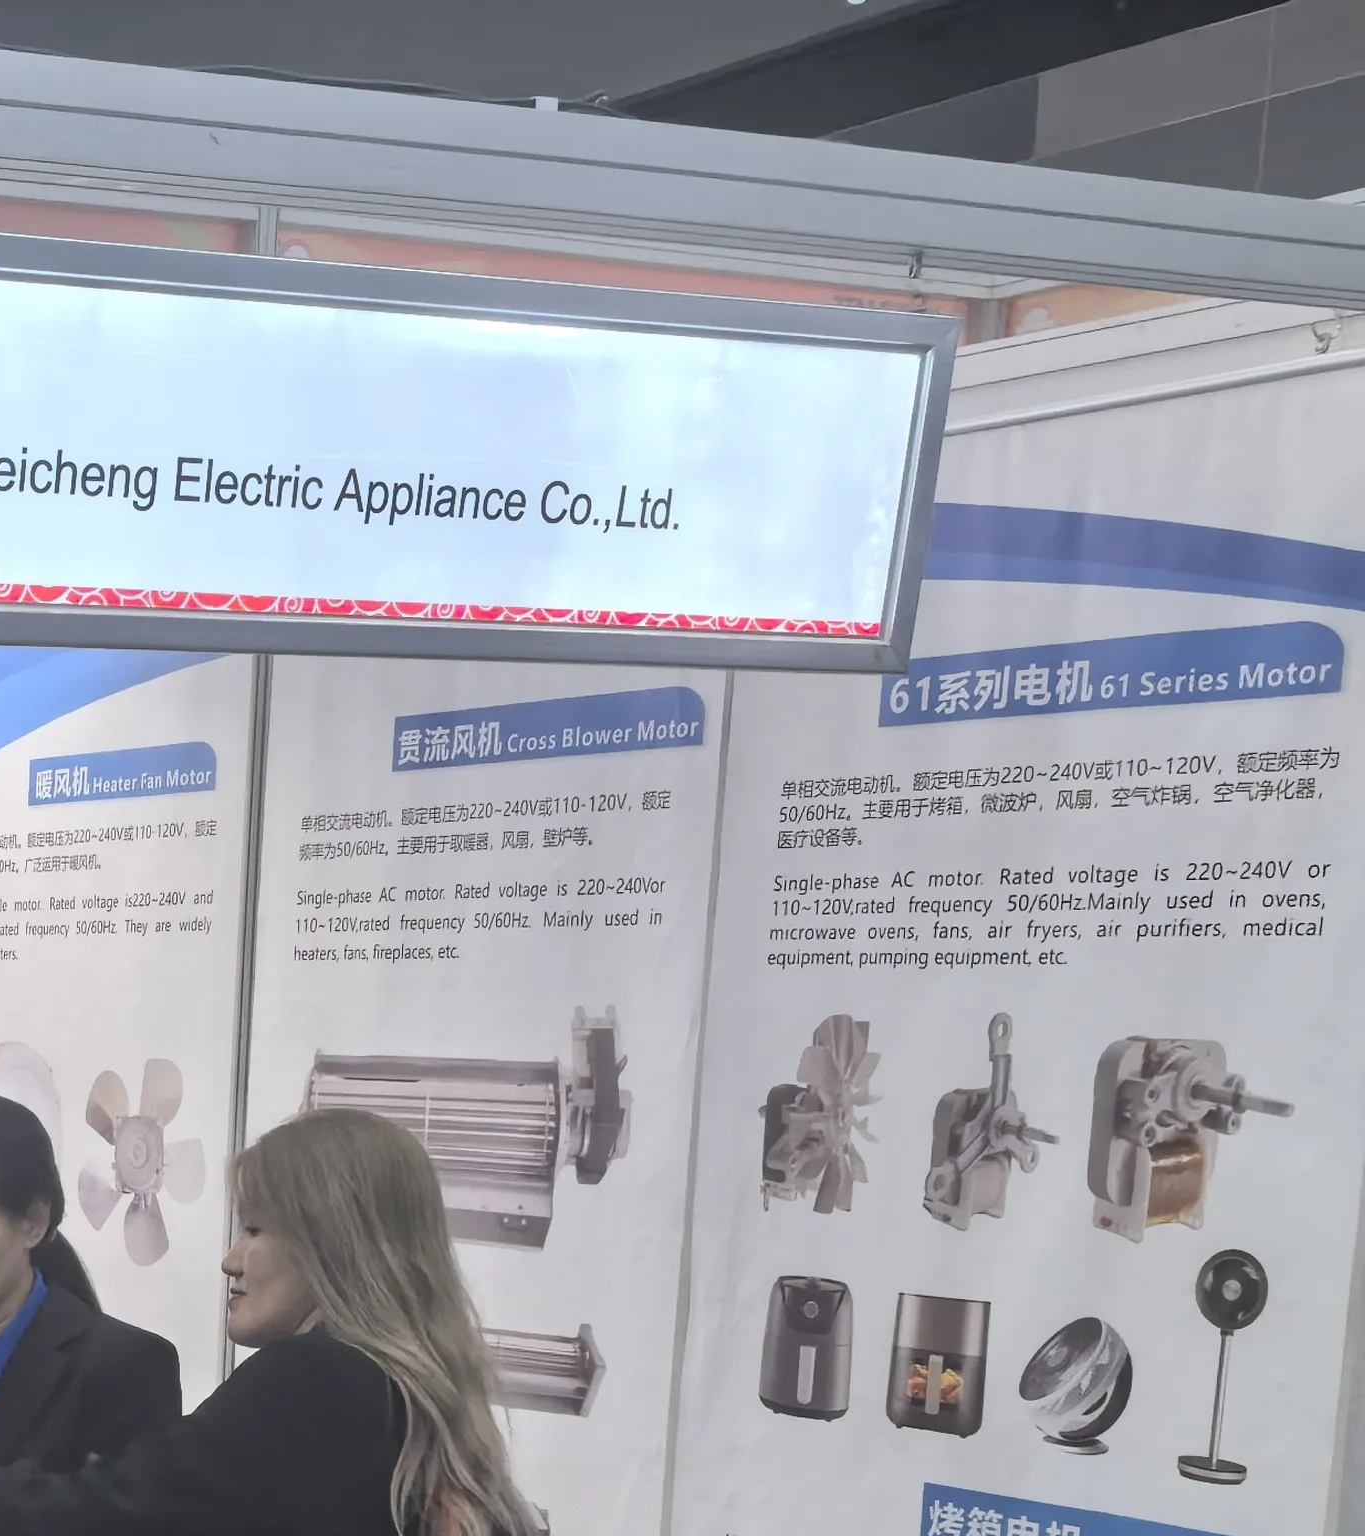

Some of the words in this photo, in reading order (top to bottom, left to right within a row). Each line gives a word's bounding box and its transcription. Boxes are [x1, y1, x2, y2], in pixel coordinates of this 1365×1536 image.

[174, 457, 323, 510] Electric
[334, 469, 526, 525] Appliance
[541, 481, 678, 533] Co.,Ltd.
[890, 660, 1093, 714] 61系列电机
[1101, 674, 1128, 698] 61
[1140, 672, 1228, 696] Series
[1239, 663, 1331, 688] Motor
[398, 721, 502, 765] 贯流风机
[508, 734, 555, 752] Cross
[562, 727, 632, 748] Blower
[638, 720, 698, 741] Motor
[36, 766, 89, 799] 暖风机
[93, 776, 137, 793] Heater
[141, 773, 161, 789] Fan
[167, 769, 211, 787] Motor
[773, 873, 879, 895] Single-phase
[891, 870, 915, 888] AC
[1000, 866, 1054, 885] Rated
[1069, 864, 1138, 888] voltage
[1155, 863, 1169, 882] is
[1308, 864, 1331, 878] or
[297, 888, 371, 909] Single-phase
[379, 886, 397, 902] AC
[455, 882, 490, 900] Rated
[499, 881, 547, 902] voltage
[557, 880, 567, 896] is
[909, 896, 993, 918] frequency
[1167, 890, 1213, 909] used
[1230, 890, 1245, 908] in
[401, 914, 465, 934] frequency
[543, 910, 593, 931] Mainly
[605, 909, 639, 926] used
[649, 908, 662, 925] in
[770, 928, 855, 940] microwave
[987, 920, 1013, 938] air
[1097, 920, 1122, 938] air
[1243, 916, 1323, 936] medical
[859, 948, 929, 970] pumping
